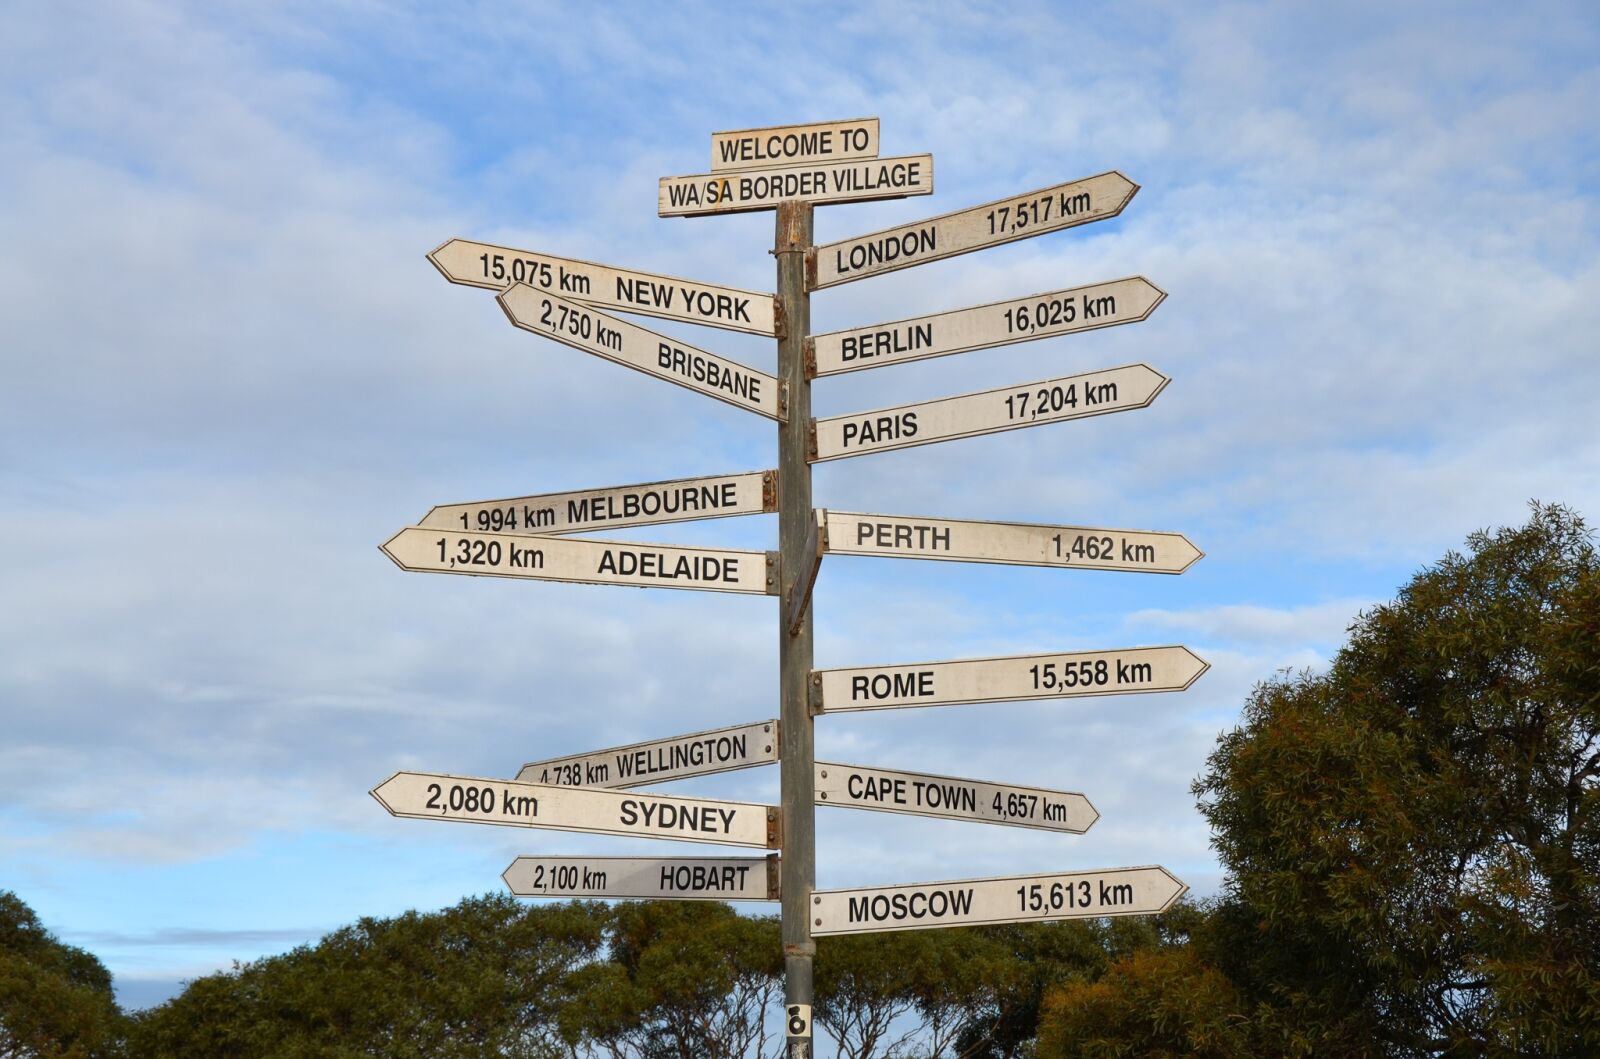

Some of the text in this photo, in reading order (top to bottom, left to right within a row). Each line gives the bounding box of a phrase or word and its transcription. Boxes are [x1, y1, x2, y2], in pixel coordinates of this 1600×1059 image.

[720, 128, 869, 162] WELCOME TO
[669, 162, 920, 208] WA/SA BORDER VILLAGE
[837, 192, 1091, 274] LONDON 17,517 km
[480, 253, 750, 322] 15,075 km NEW YORK
[540, 299, 760, 403] 2,750 km BRISBANE
[841, 295, 1116, 361] BERLIN 16,025 km
[843, 381, 1118, 447] PARIS 17,204 km
[524, 506, 555, 528] km
[567, 483, 737, 523] MELBOURNE
[436, 538, 739, 583] 1,320 km ADELAIDE
[857, 522, 1155, 563] PERTH 1,462 km
[852, 659, 1152, 700] ROME 15,558 km
[586, 761, 608, 784] km
[617, 734, 746, 778] WELLINGTON
[425, 783, 736, 834] 2,080 km SYDNEY
[848, 774, 1067, 822] CAPE TOWN 4,657 km
[533, 865, 749, 892] 2,100 km HOBART
[848, 880, 1133, 922] MOSCOW 15,613 km
